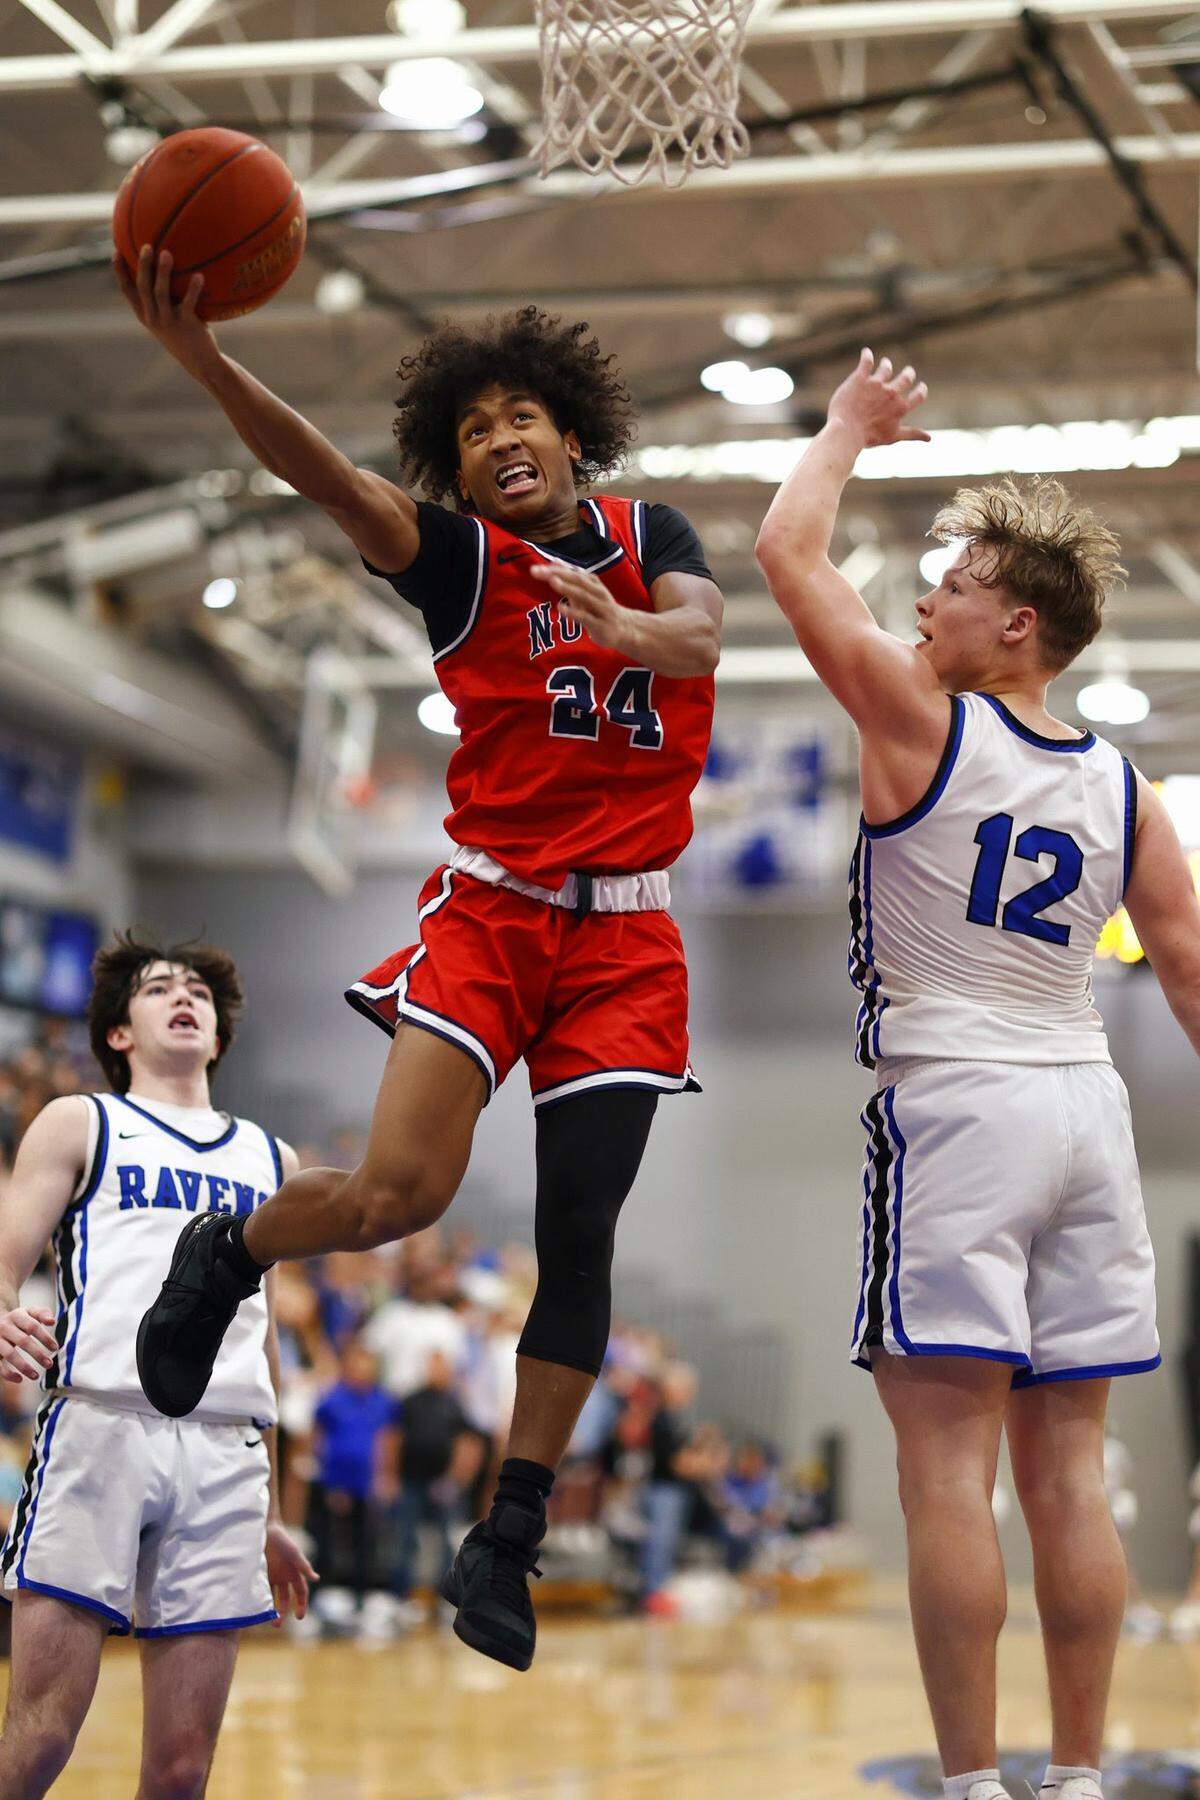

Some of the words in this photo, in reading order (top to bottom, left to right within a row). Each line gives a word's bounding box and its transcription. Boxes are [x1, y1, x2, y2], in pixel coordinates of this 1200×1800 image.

[546, 665, 663, 750] 24
[966, 812, 1084, 947] 12
[117, 1165, 269, 1216] RAVEN
